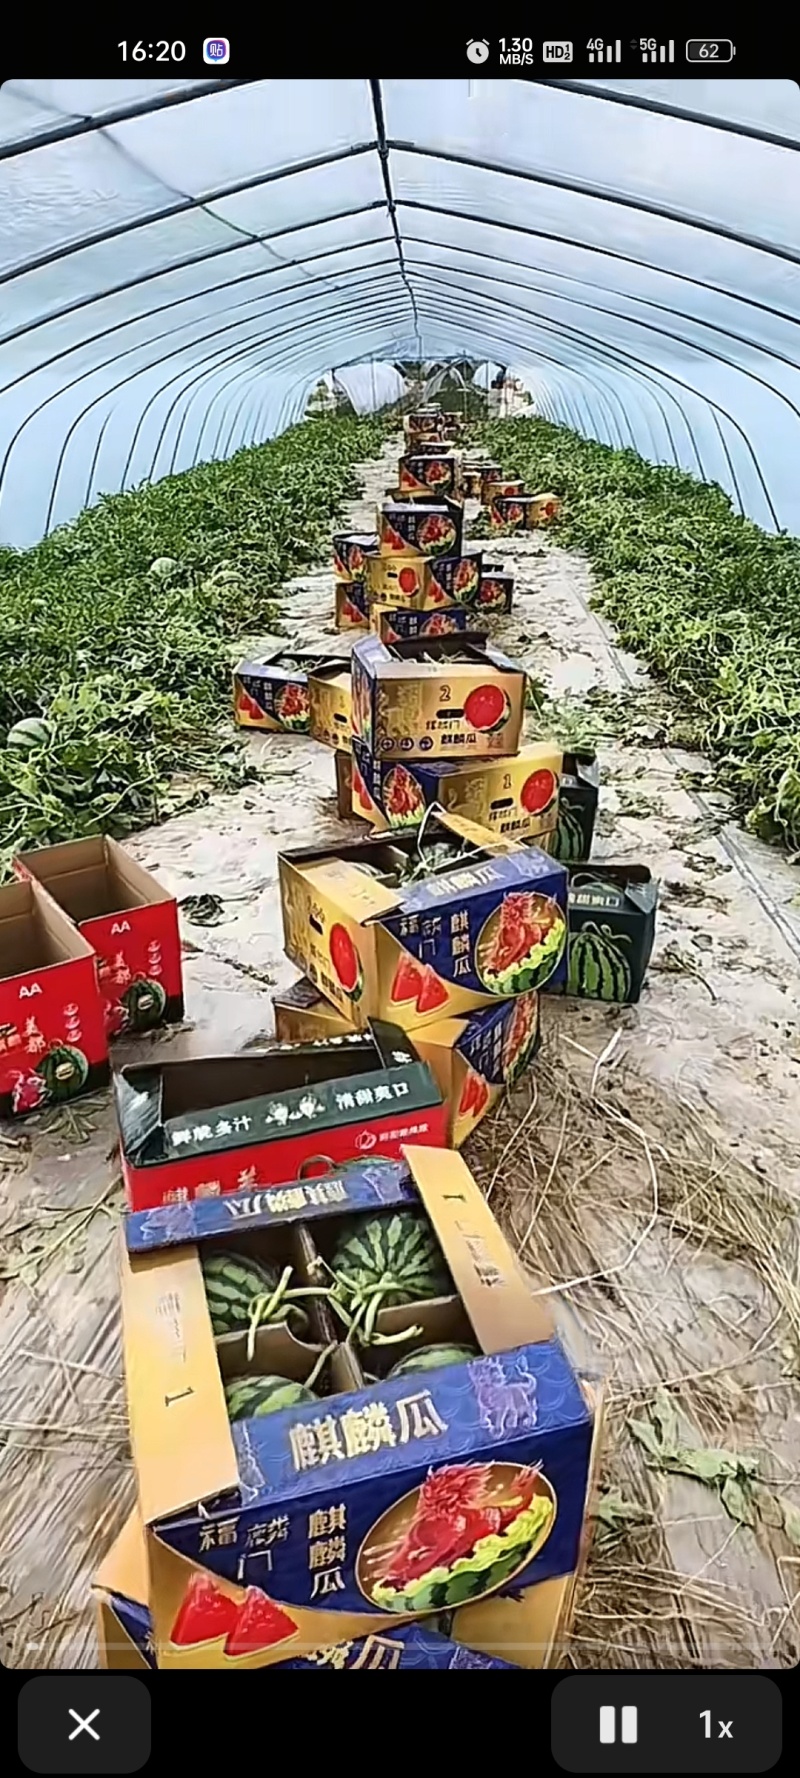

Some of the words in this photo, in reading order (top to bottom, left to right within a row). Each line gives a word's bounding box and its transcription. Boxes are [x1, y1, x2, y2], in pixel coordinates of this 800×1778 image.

[118, 40, 186, 62] 16:20
[499, 37, 533, 52] 1.30
[586, 38, 604, 50] 4G
[639, 38, 657, 50] 5G
[699, 44, 719, 58] 62
[499, 53, 534, 65] MB/S
[111, 921, 131, 935] AA
[451, 910, 472, 978] 麒麟瓜
[19, 983, 43, 999] AA
[289, 1389, 448, 1472] 麒麟瓜
[308, 1503, 346, 1600] 麒麟瓜
[699, 1709, 734, 1739] 1x
